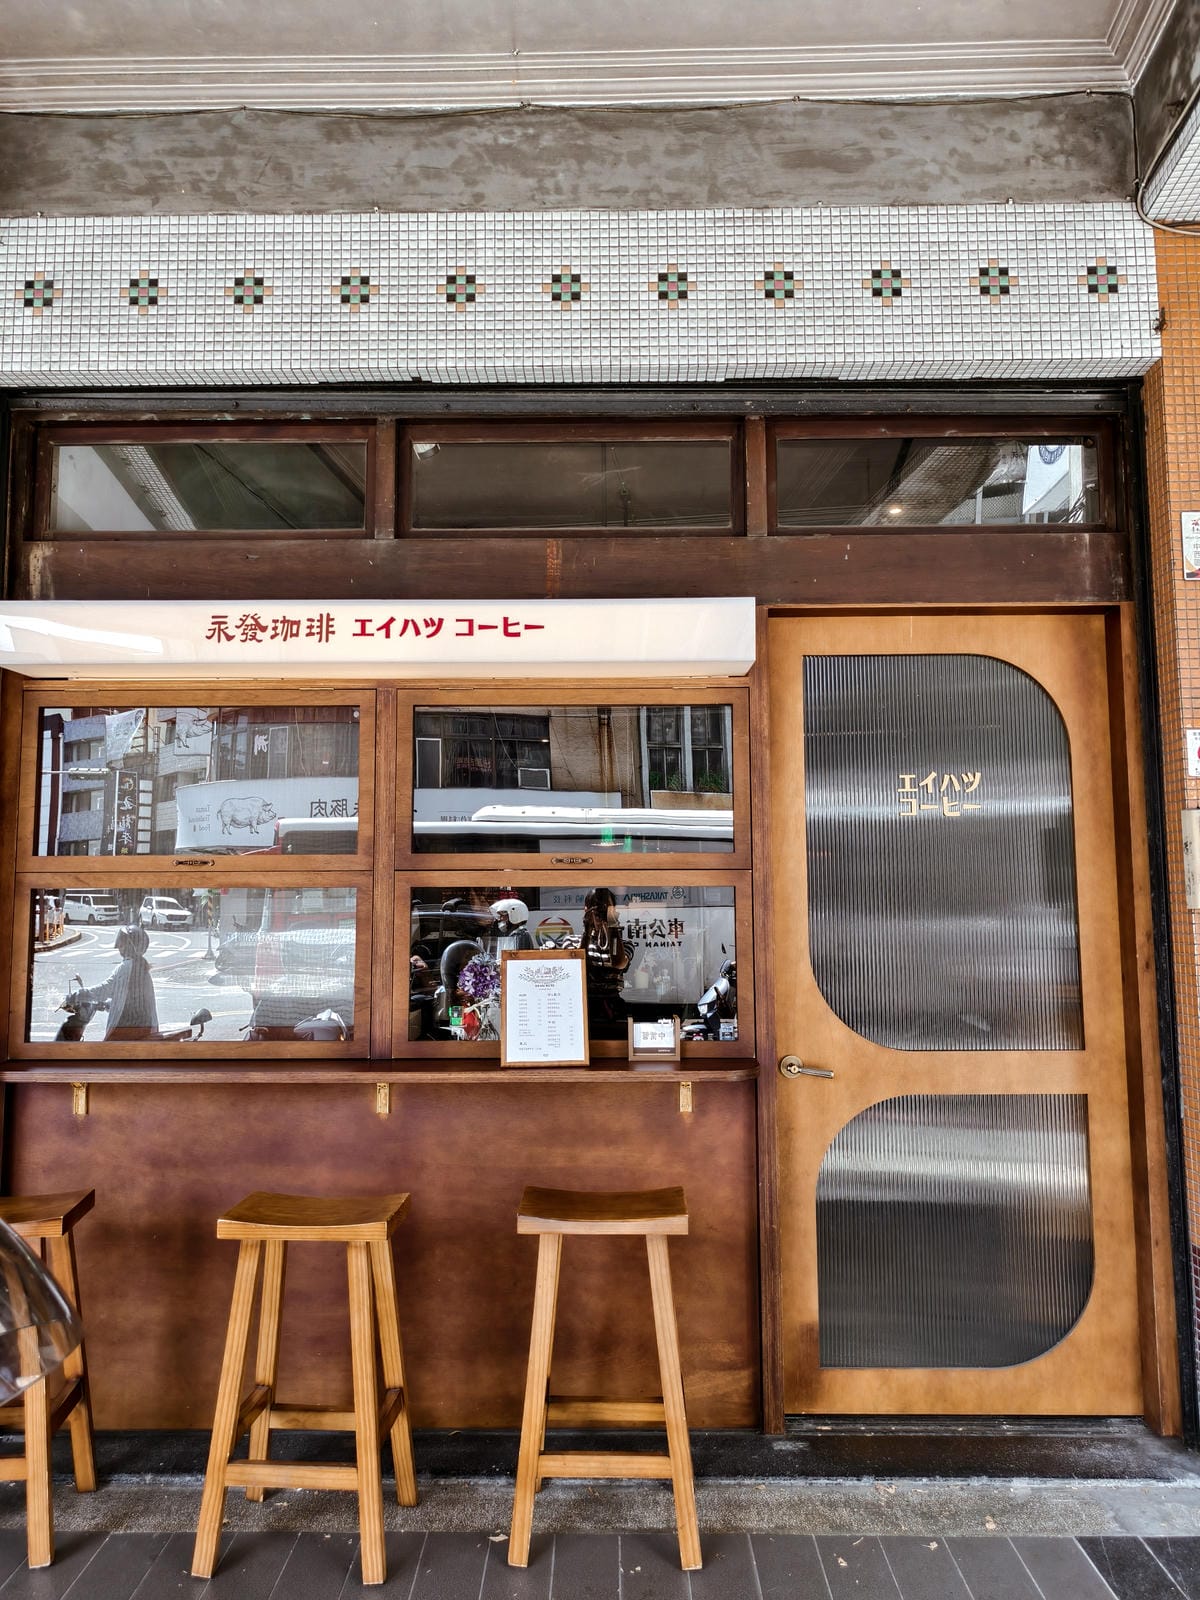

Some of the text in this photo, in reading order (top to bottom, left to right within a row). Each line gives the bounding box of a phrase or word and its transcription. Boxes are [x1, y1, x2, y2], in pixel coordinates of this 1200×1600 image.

[205, 612, 545, 643] 永發珈琲 エイハツ コーヒー
[897, 771, 982, 794] エイハツ
[899, 796, 982, 817] コーヒー
